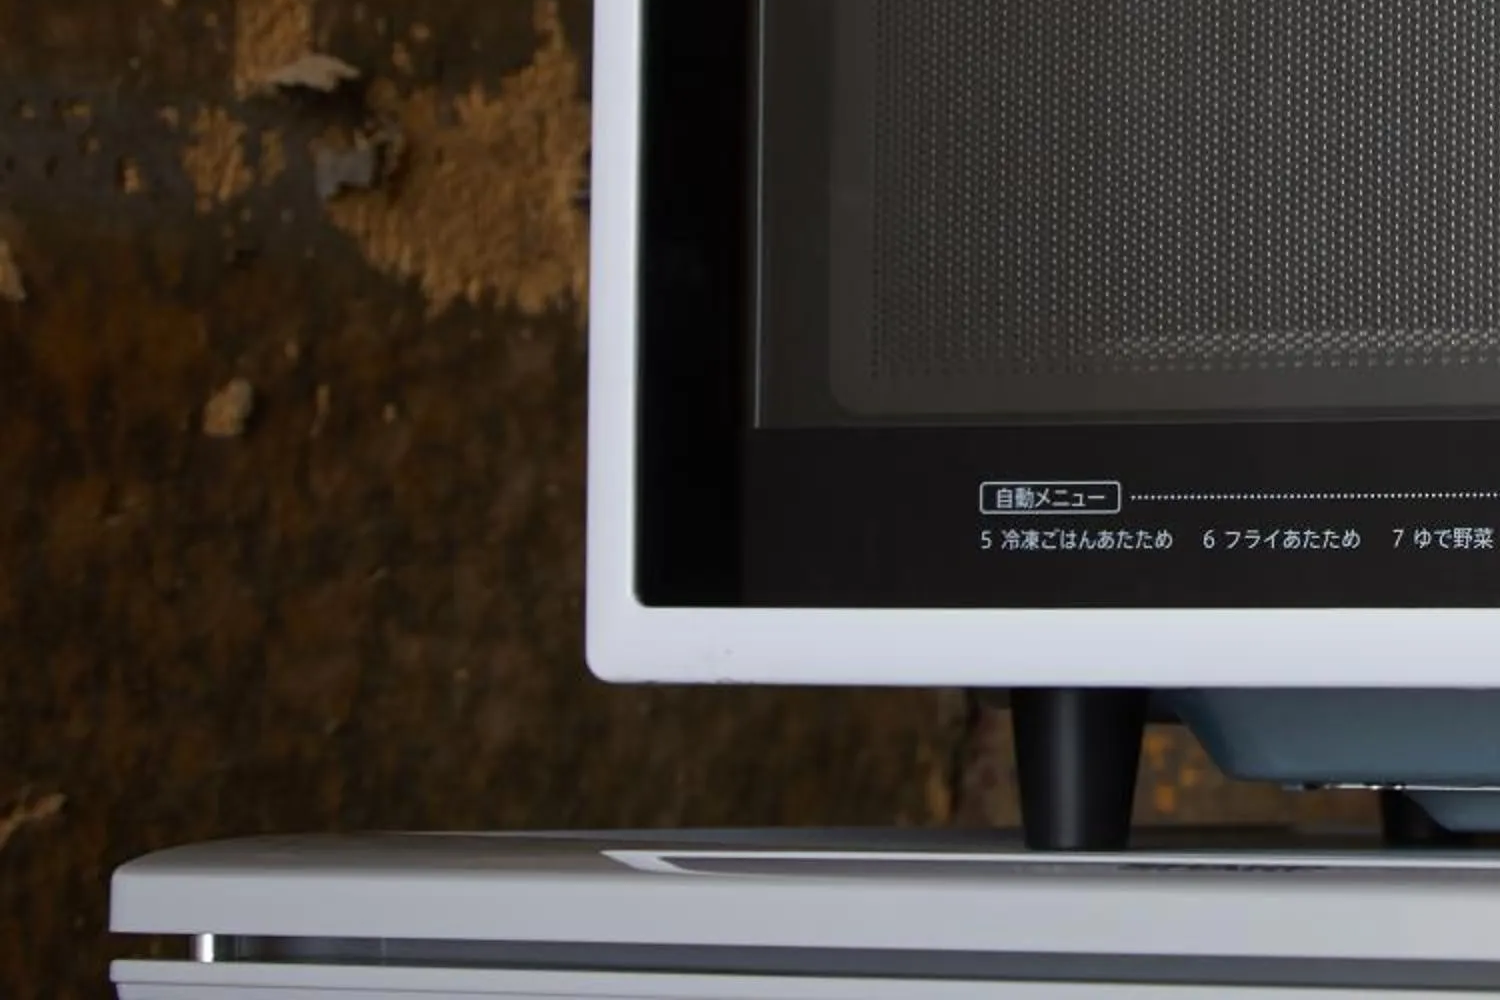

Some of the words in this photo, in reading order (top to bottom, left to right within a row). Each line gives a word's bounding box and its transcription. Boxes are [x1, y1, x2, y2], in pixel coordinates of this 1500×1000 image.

[995, 487, 1107, 508] 自動メニュー
[981, 530, 992, 549] 5
[1000, 528, 1174, 550] 冷凍ごはんあたため
[1203, 530, 1215, 549] 6
[1224, 528, 1362, 550] フライあたため
[1392, 529, 1404, 548] 7
[1413, 526, 1495, 549] ゆで野菜
